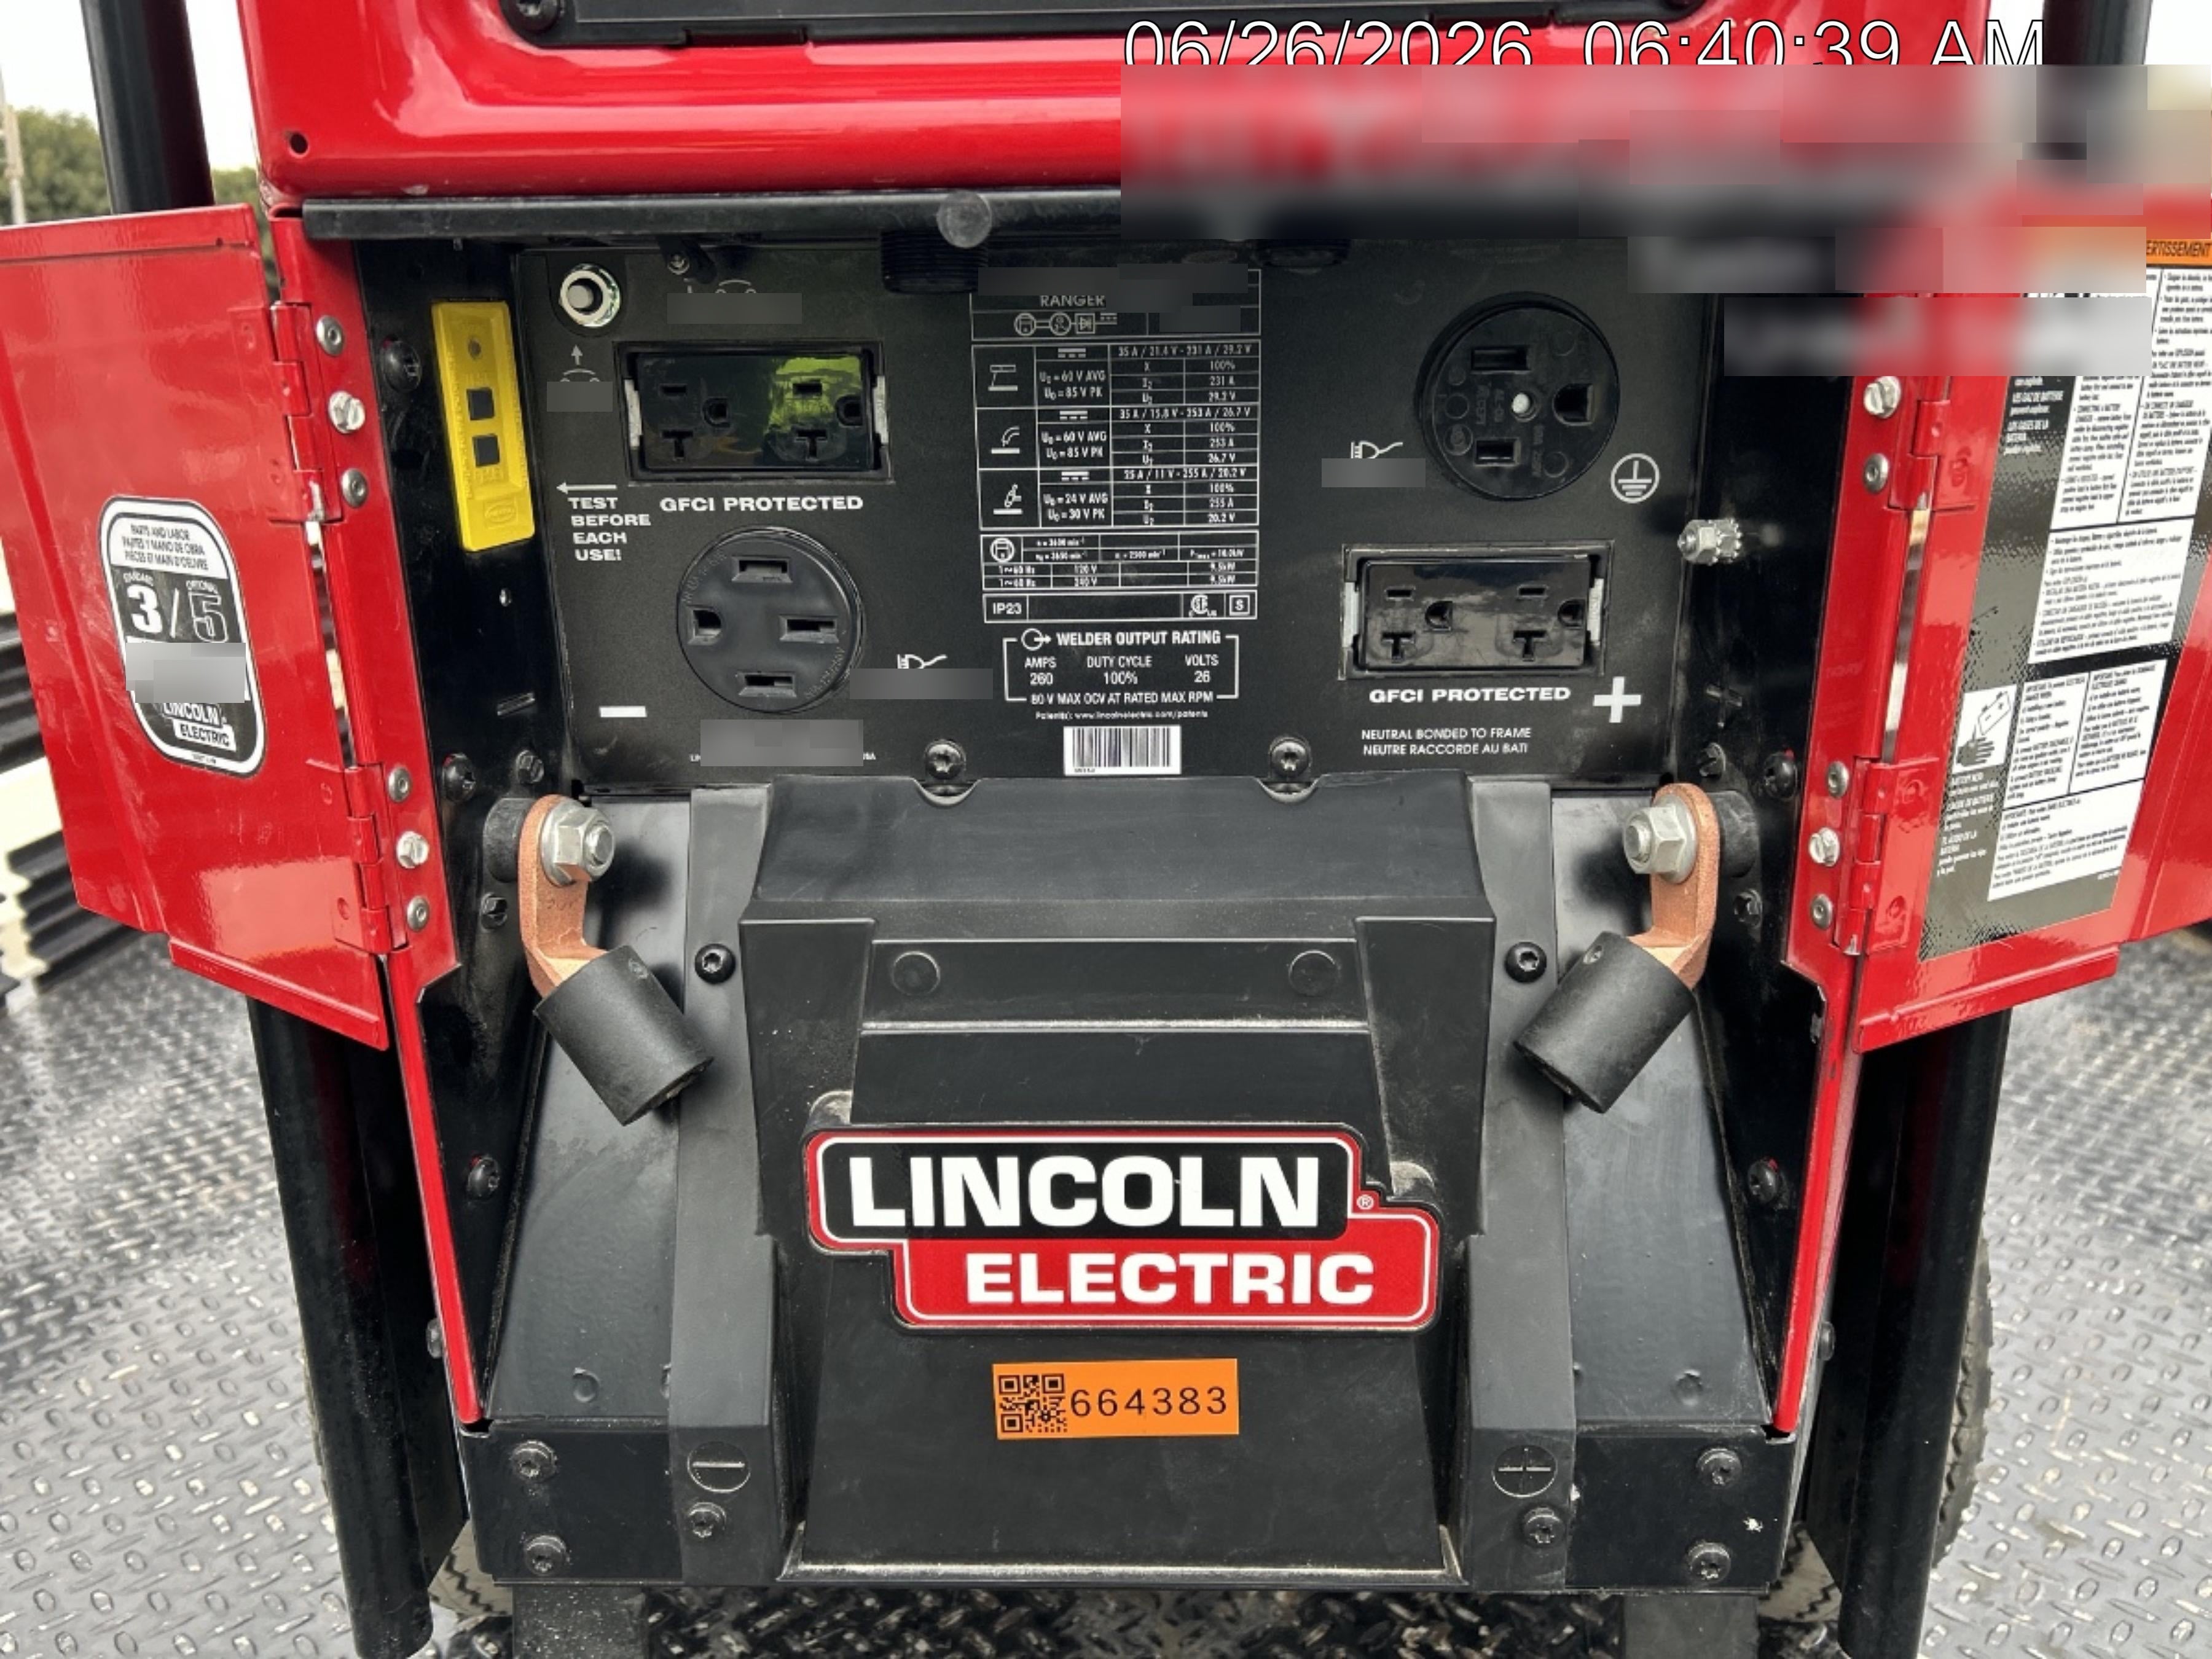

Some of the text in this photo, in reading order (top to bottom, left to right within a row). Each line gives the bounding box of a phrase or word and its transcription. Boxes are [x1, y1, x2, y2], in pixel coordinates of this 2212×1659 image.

[1040, 296, 1105, 307] RANGER
[1210, 360, 1236, 371] 100%
[1076, 370, 1083, 382] V
[1086, 370, 1105, 382] AVG
[1209, 375, 1225, 386] 231
[1080, 386, 1086, 398] V
[1090, 386, 1103, 398] PK
[1210, 422, 1235, 433] 100%
[1078, 431, 1084, 442] V
[1087, 431, 1107, 442] AVG
[1081, 446, 1088, 458] V
[1090, 446, 1103, 458] PK
[1229, 453, 1236, 463] V
[568, 498, 618, 509] TEST
[660, 496, 864, 512] GFCI PROTECTED
[1079, 493, 1086, 503] V
[1089, 493, 1108, 504] AVG
[1228, 497, 1234, 508] A
[1083, 508, 1089, 520] V
[1092, 508, 1105, 519] PK
[1229, 512, 1236, 522] V
[571, 514, 651, 527] BEFORE
[573, 531, 627, 545] EACH
[575, 549, 622, 562] USE!
[1091, 564, 1097, 574] V
[1091, 577, 1097, 587] V
[993, 602, 1022, 614] IP23
[1234, 598, 1244, 611] S
[1056, 630, 1221, 646] WELDER OUTPUT RATING
[1024, 654, 1219, 668] AMPS DUTY CYCLE VOLTS
[1029, 670, 1211, 685] 260 100% 26
[1046, 692, 1054, 704] V
[1057, 692, 1081, 704] MAX
[1084, 692, 1105, 704] OCV
[1107, 692, 1121, 704] AT
[1124, 691, 1158, 704] RATED
[1161, 691, 1185, 703] MAX
[1188, 691, 1214, 703] RPM
[1369, 686, 1572, 704] GFCI PROTECTED
[163, 703, 219, 726] LINCOLN
[180, 724, 230, 747] ELECTRIC
[1362, 727, 1532, 740] NEUTRAL BONDED TO FRAME
[1363, 744, 1406, 756] NEUTRE
[1481, 743, 1500, 754] AU
[849, 1156, 1319, 1228] LINCOLN
[968, 1252, 1374, 1305] ELECTRIC
[1070, 1386, 1228, 1418] 664383
